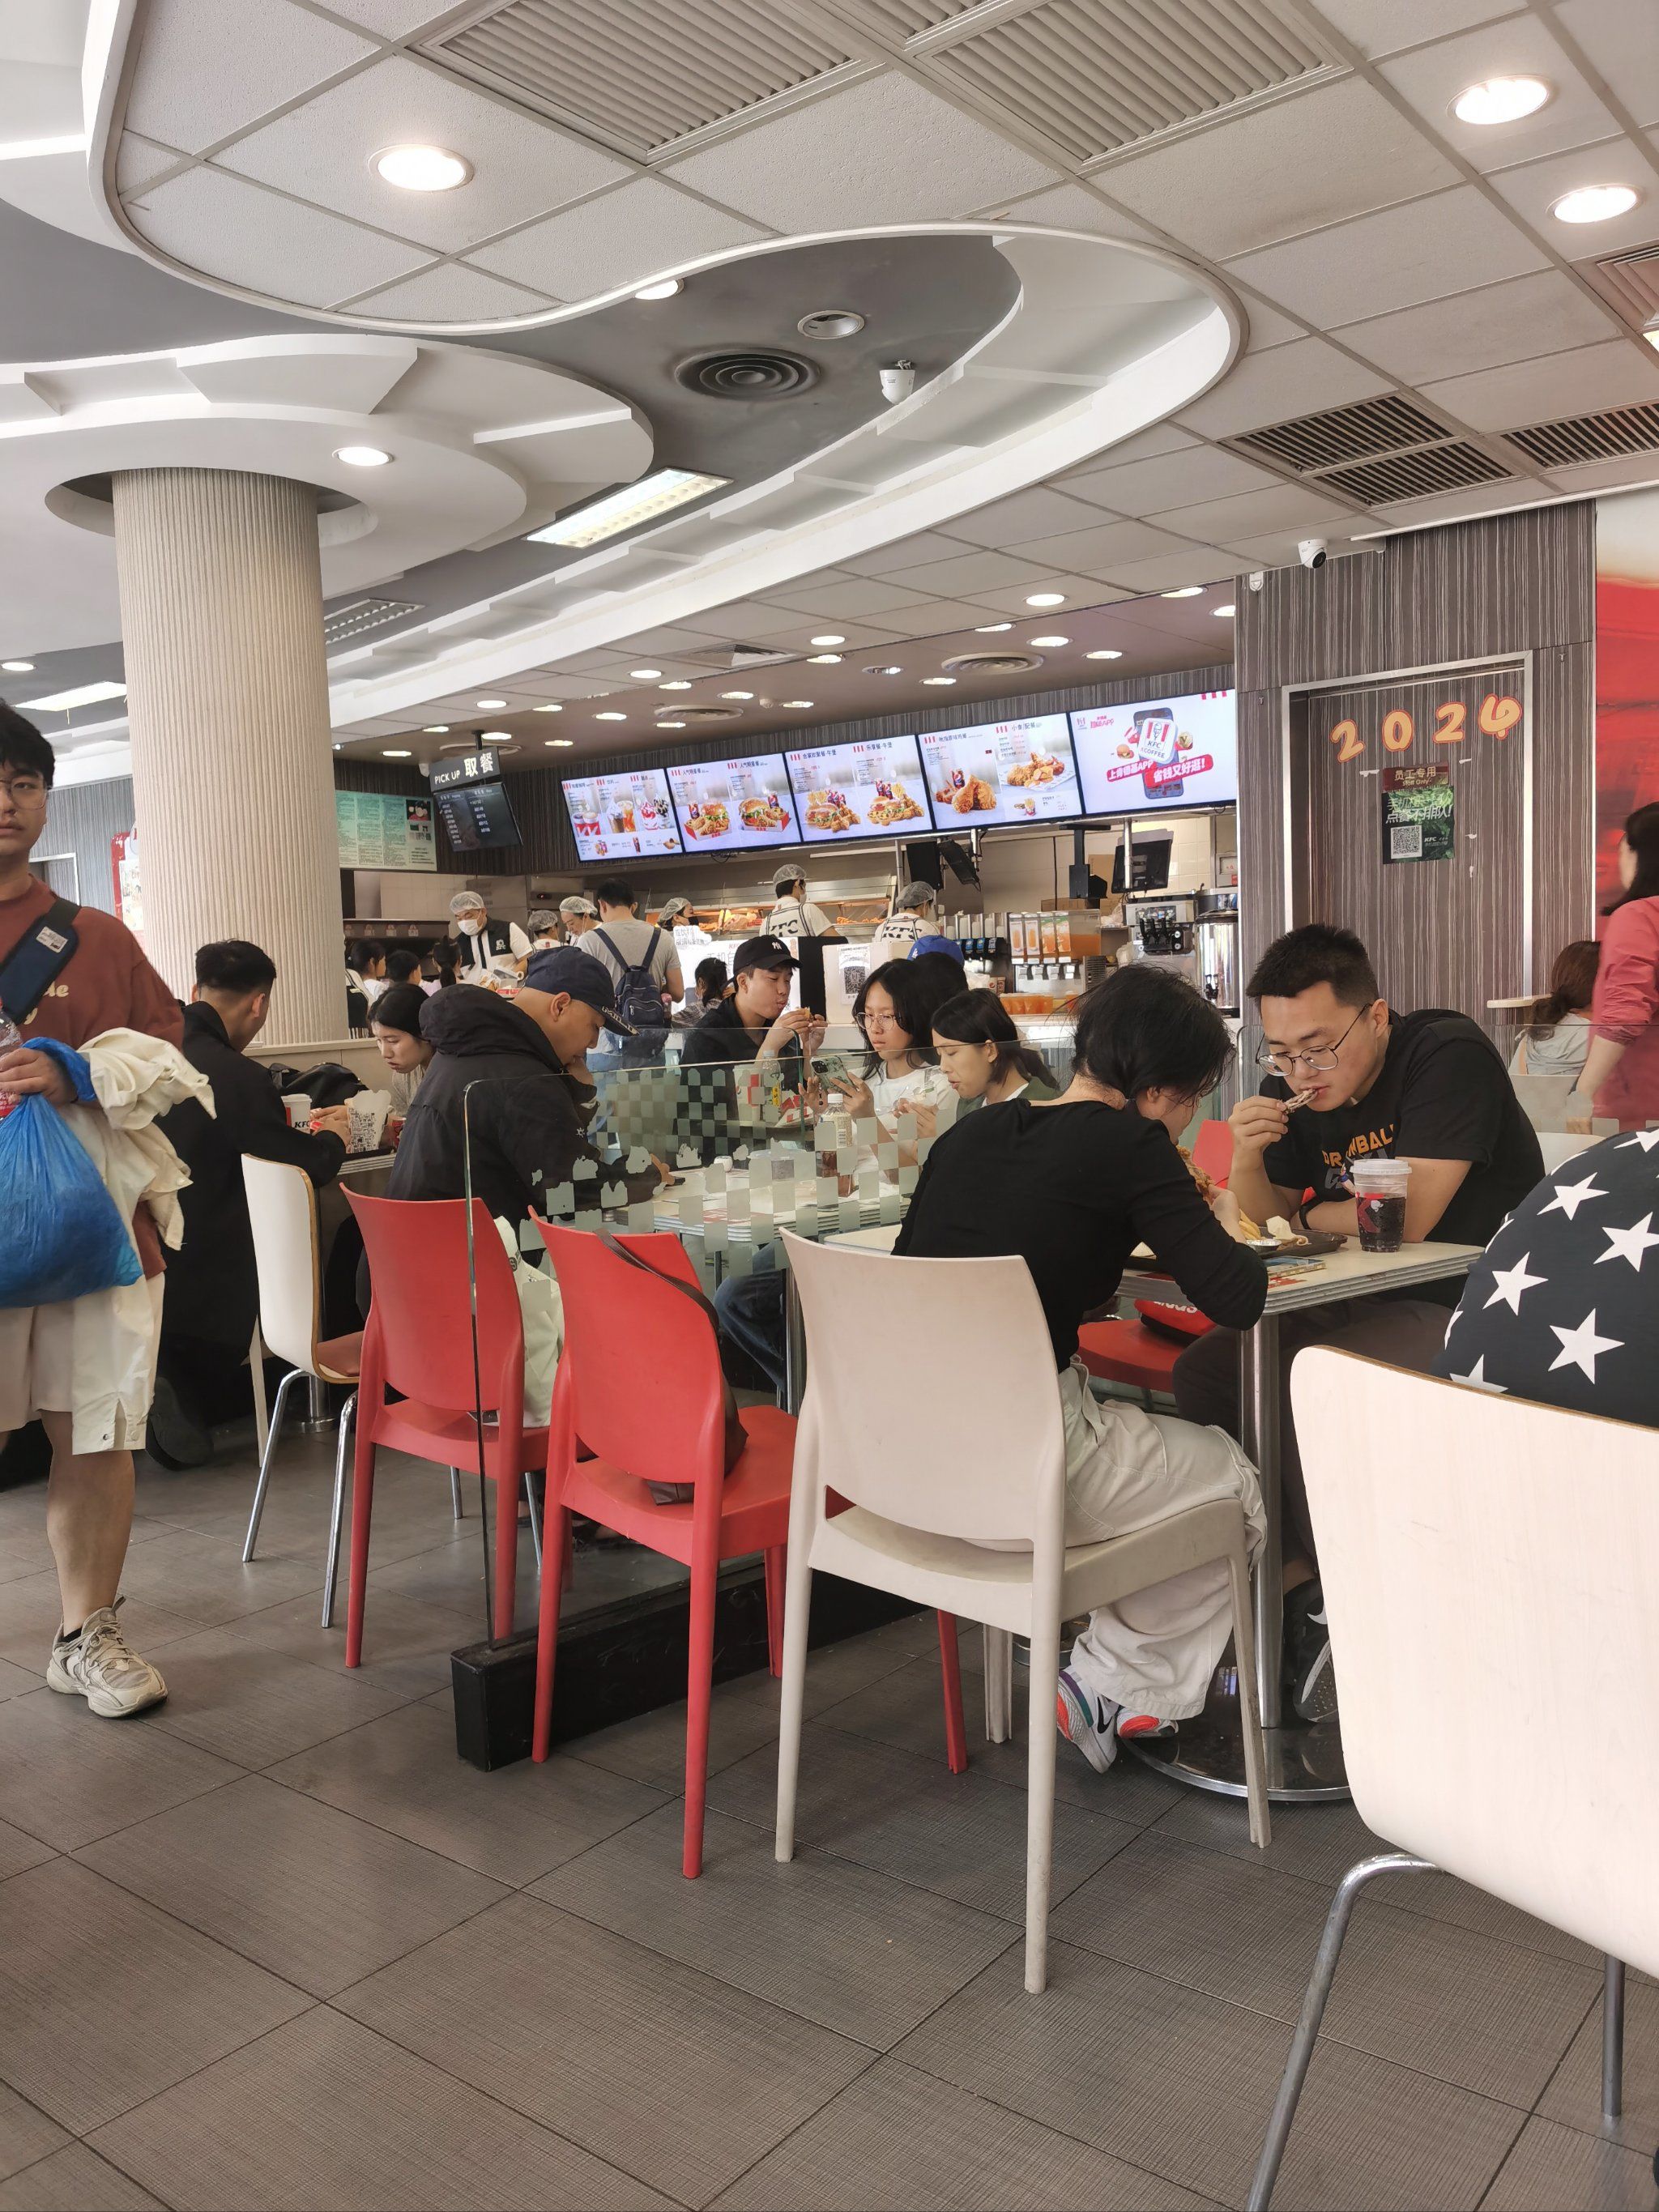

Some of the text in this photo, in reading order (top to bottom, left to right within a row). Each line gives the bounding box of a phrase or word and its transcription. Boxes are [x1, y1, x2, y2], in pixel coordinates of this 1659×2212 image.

[1147, 740, 1161, 748] KFC
[1141, 747, 1165, 758] KCOFFEE
[434, 752, 493, 784] PICK UP 取餐
[1394, 766, 1436, 781] 员工专用
